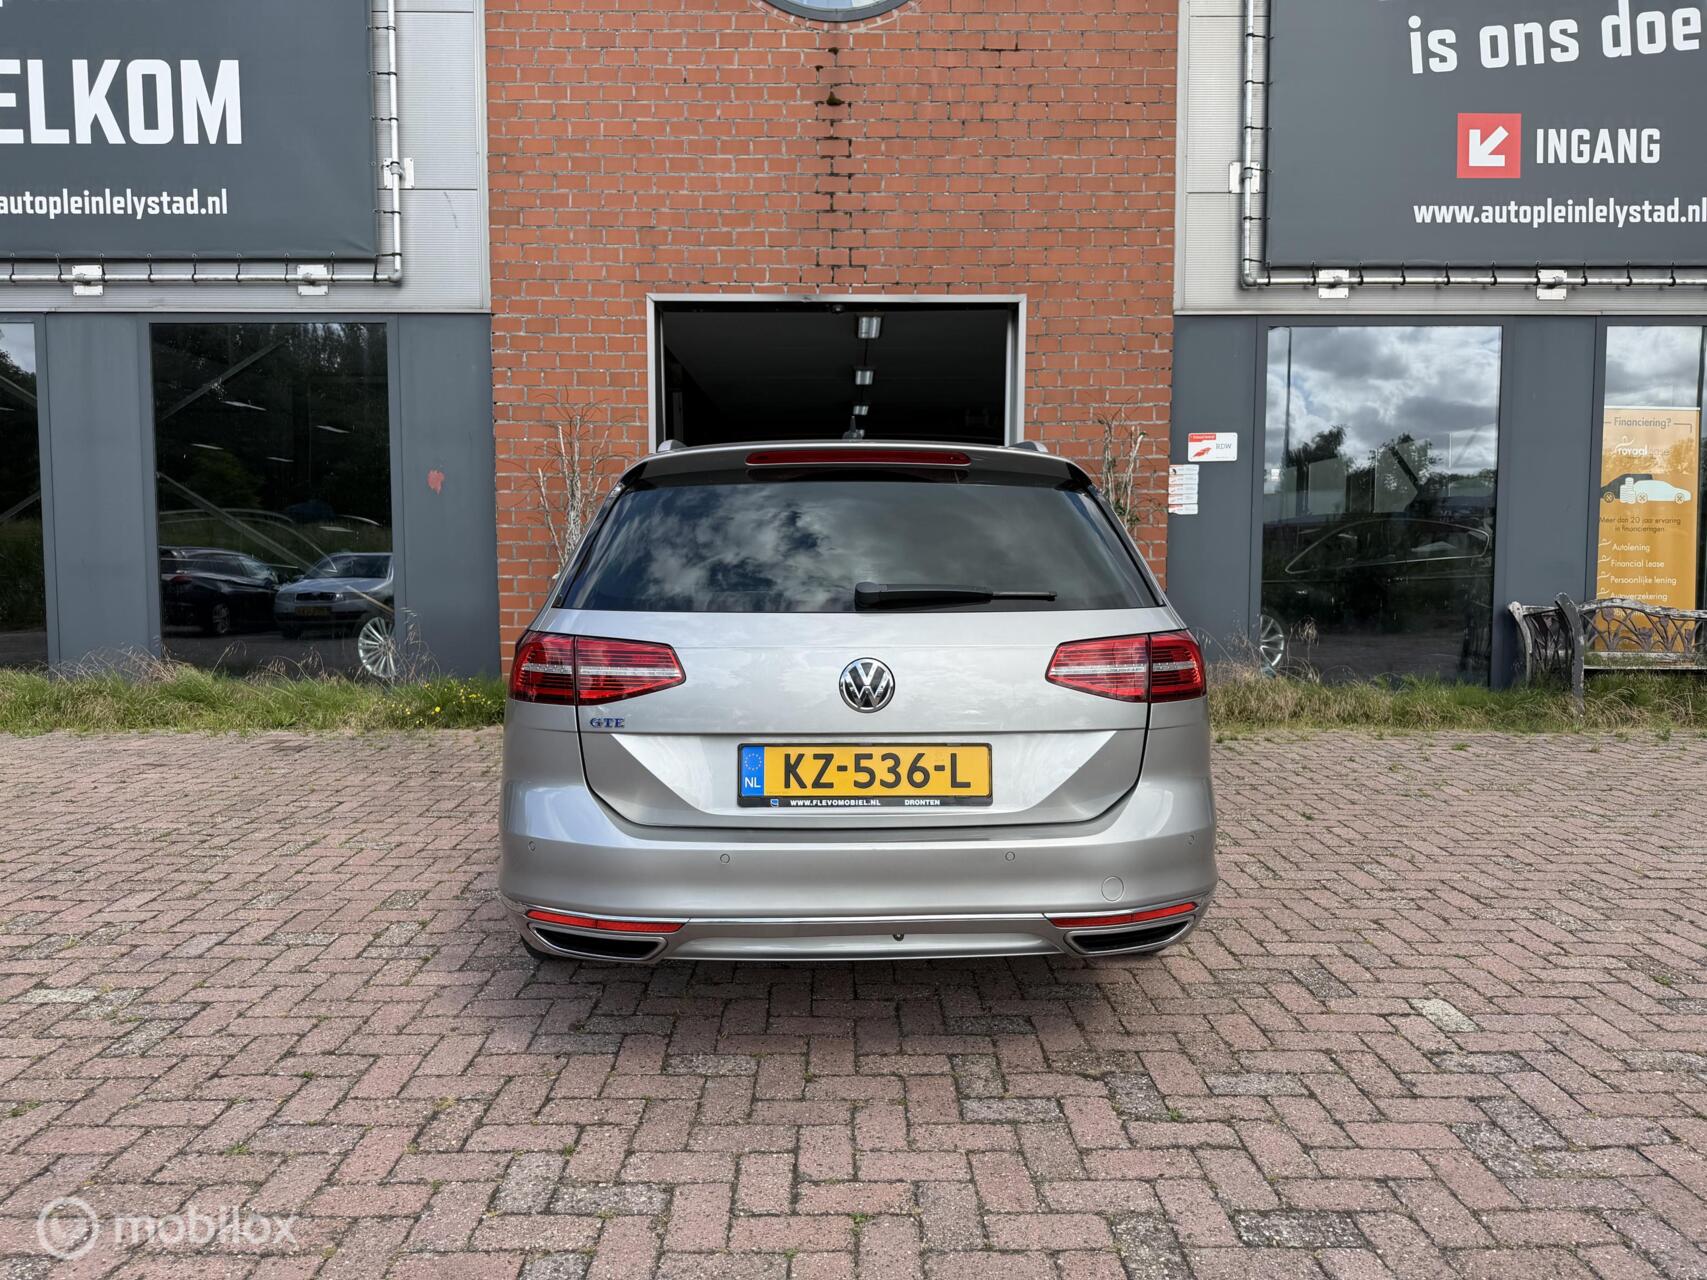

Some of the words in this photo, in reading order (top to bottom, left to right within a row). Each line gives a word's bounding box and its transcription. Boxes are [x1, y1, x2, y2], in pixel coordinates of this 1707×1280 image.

[1408, 15, 1458, 74] is
[1479, 18, 1580, 69] ons
[1601, 0, 1702, 58] doe
[0, 59, 242, 145] ELKOM
[1536, 128, 1661, 165] INGANG
[1414, 196, 1707, 228] www.autopleinlelystad.nl
[1613, 416, 1672, 429] Financiering?
[1612, 543, 1650, 553] Autolening
[1610, 559, 1644, 568] Financial
[1610, 576, 1652, 585] Persoonlijke
[1653, 576, 1677, 586] lening
[590, 717, 625, 728] GTE
[745, 777, 761, 788] NL
[783, 752, 972, 789] KZ-536-L
